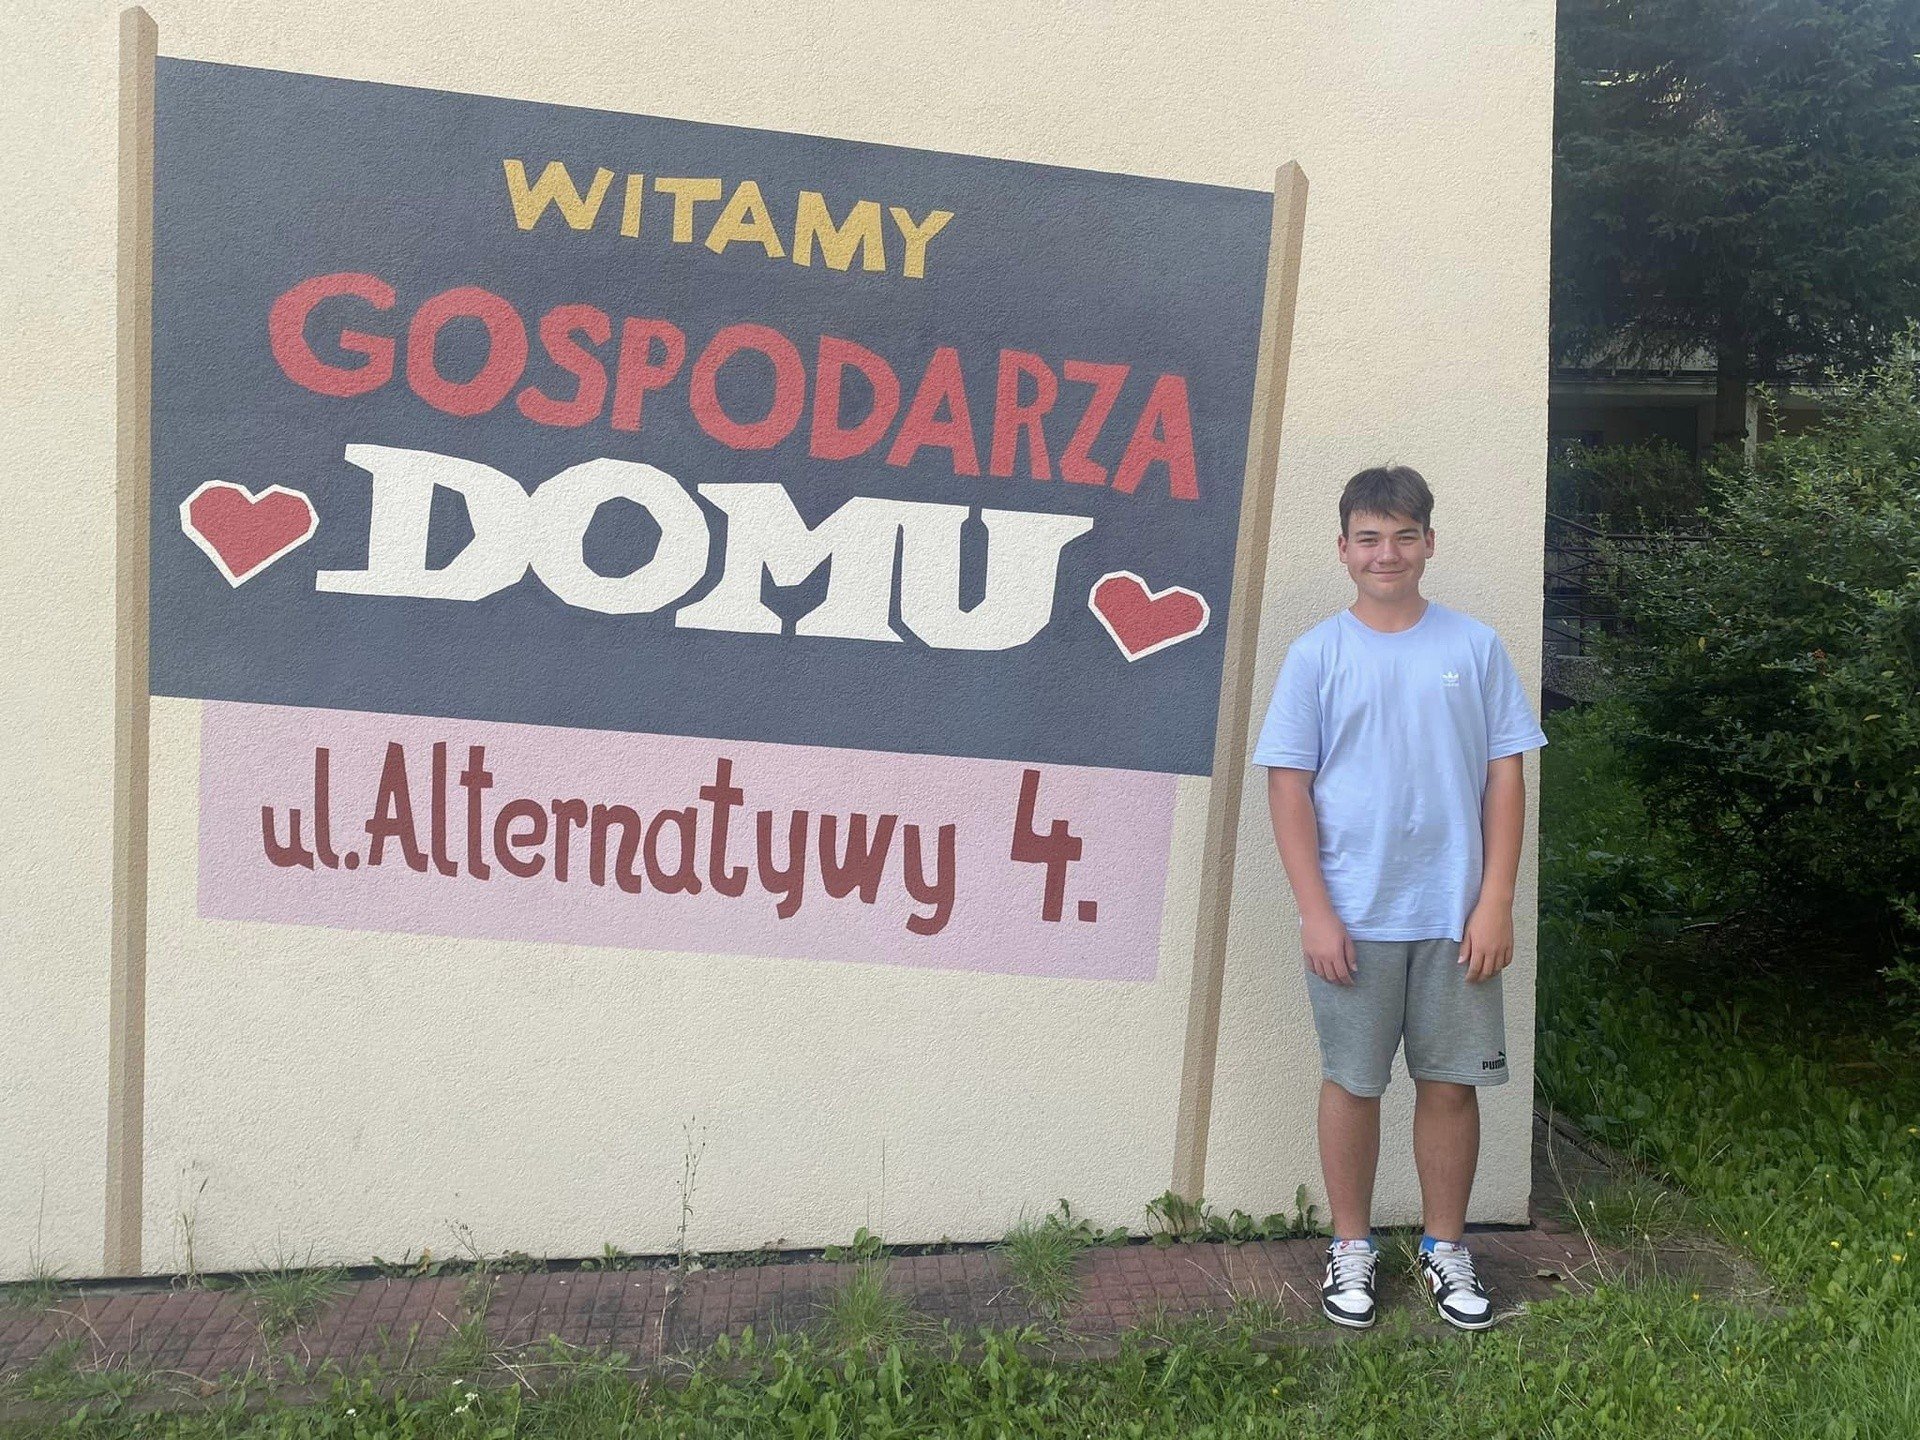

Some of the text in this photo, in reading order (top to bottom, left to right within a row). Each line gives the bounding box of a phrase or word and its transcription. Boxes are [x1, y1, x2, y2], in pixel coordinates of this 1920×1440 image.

[503, 158, 955, 279] WITAMY
[268, 271, 1201, 501] GOSPODARZA
[316, 444, 1094, 651] DOMU
[1011, 769, 1098, 924] 4.
